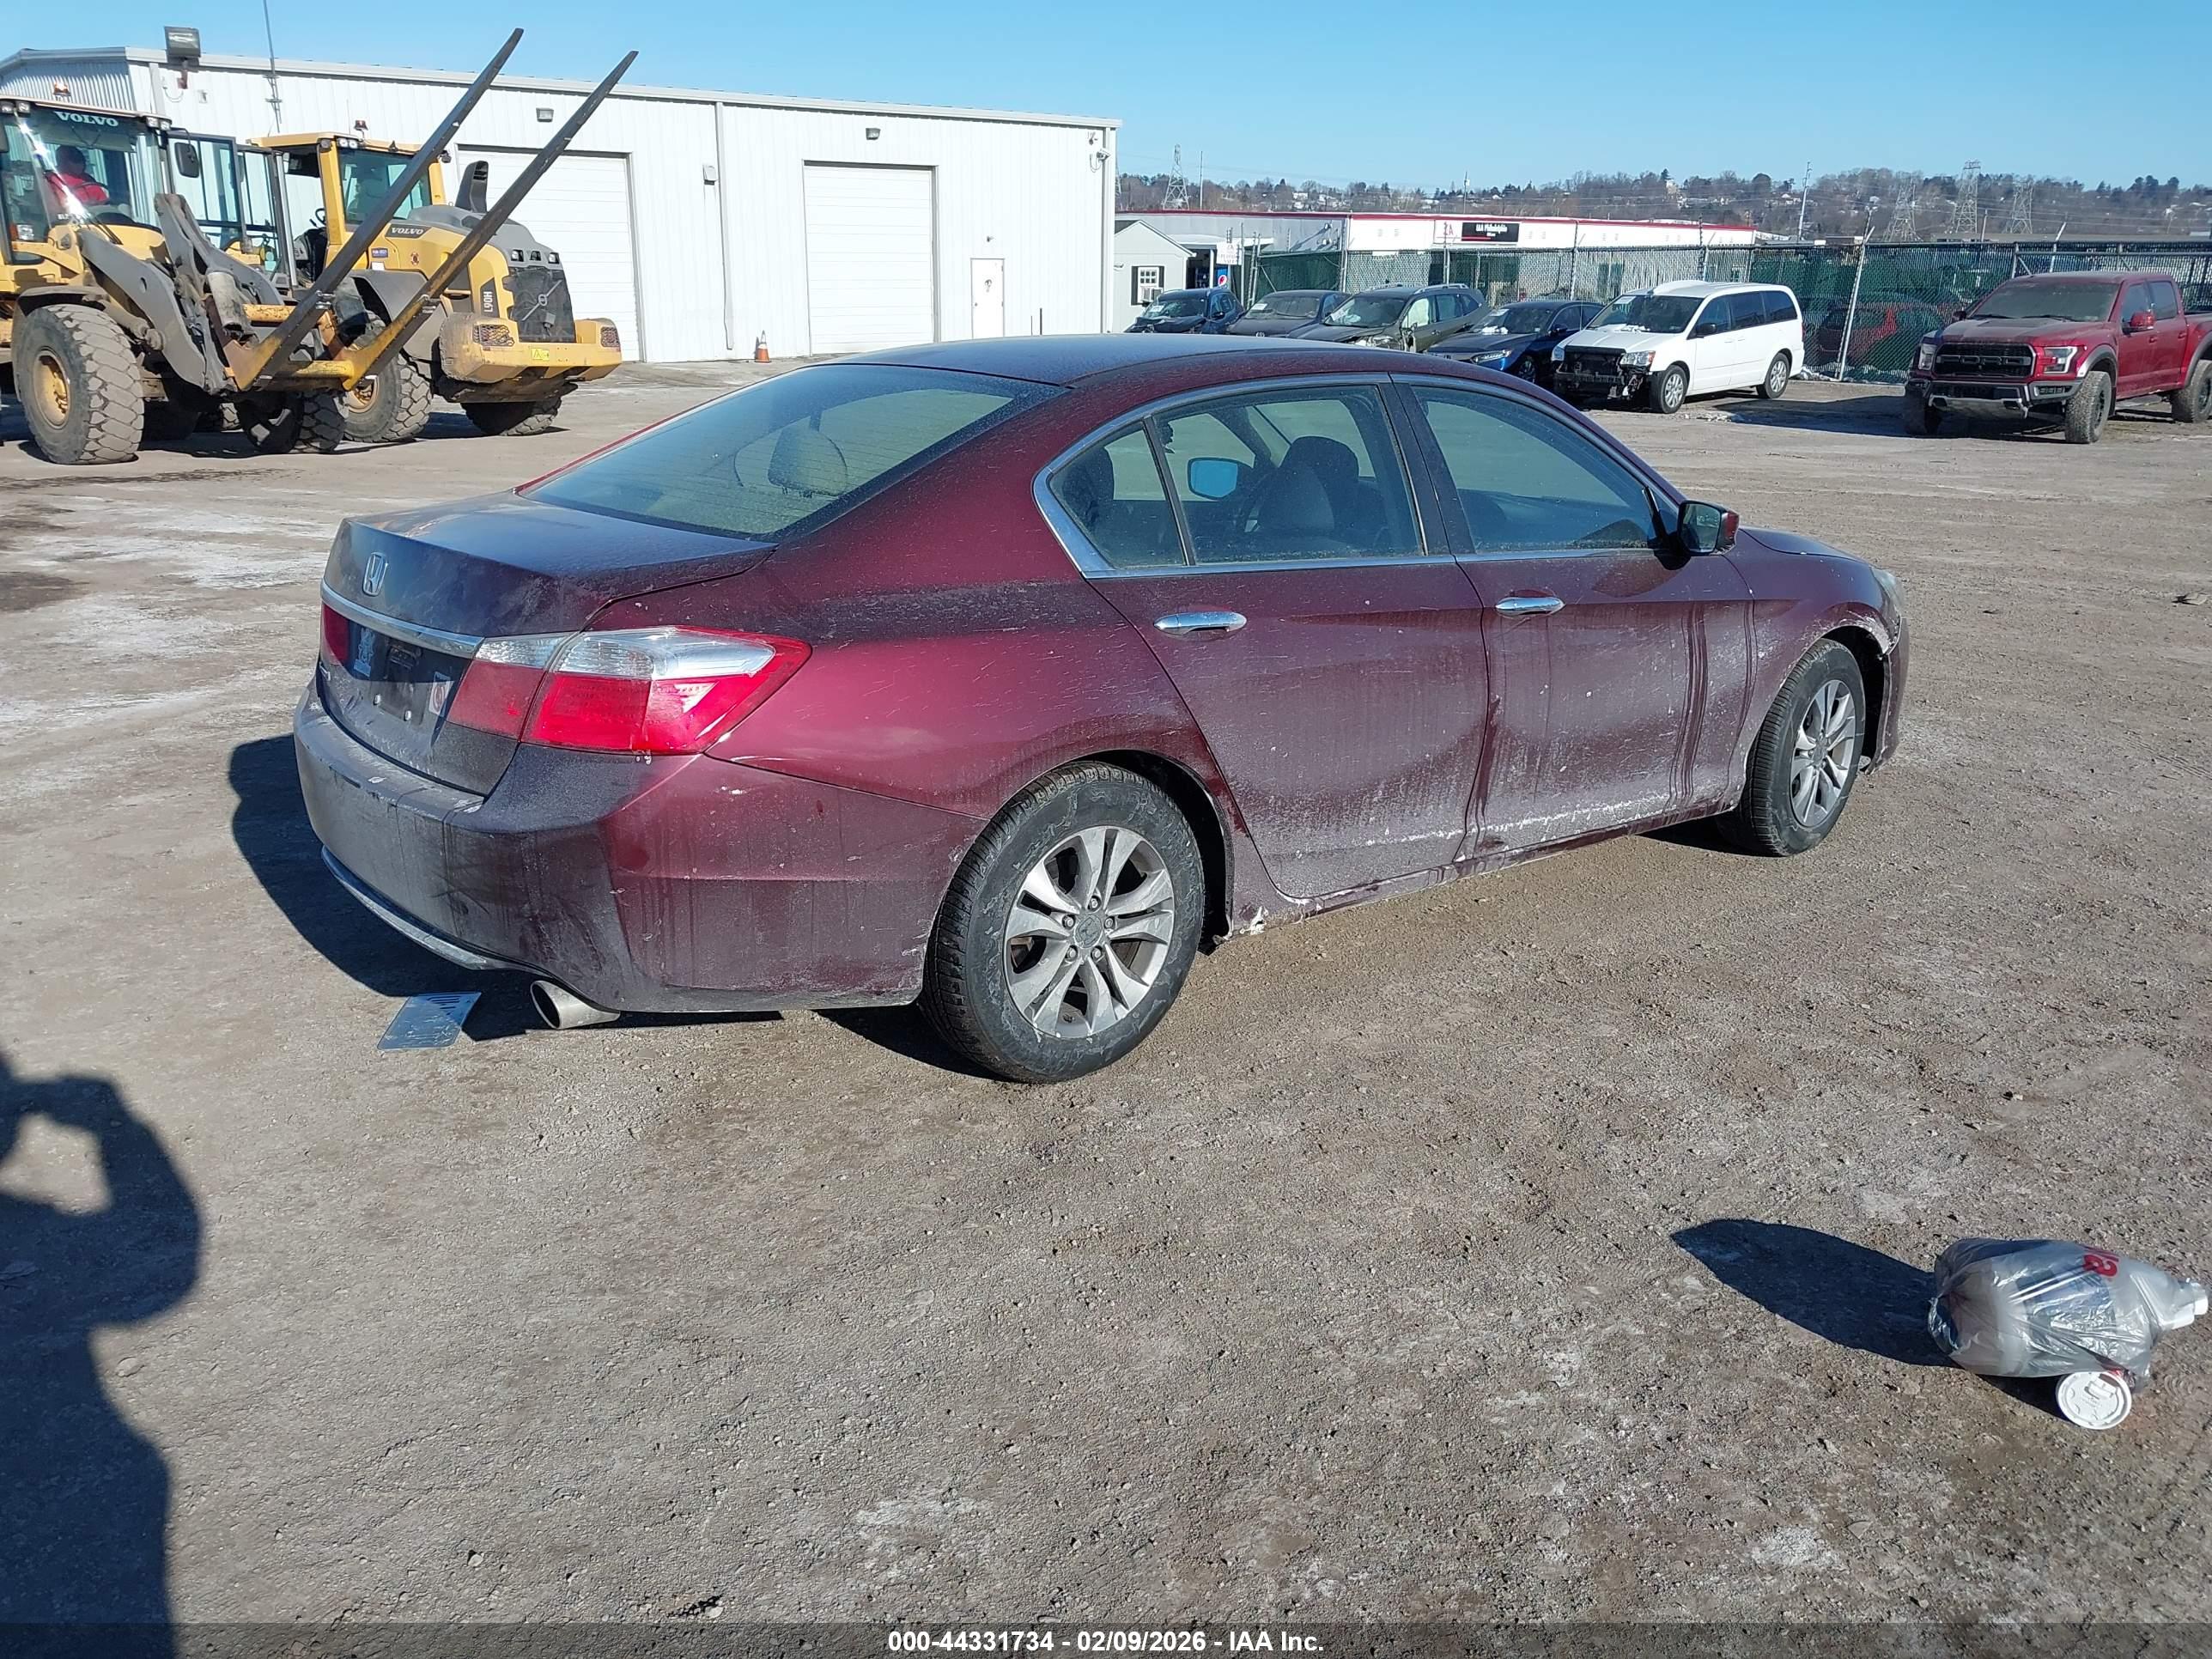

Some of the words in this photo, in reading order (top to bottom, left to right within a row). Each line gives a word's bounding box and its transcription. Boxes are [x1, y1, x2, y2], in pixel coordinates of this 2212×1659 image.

[53, 111, 118, 127] VOLVO
[392, 227, 424, 235] VOLVO
[483, 291, 494, 313] L90H
